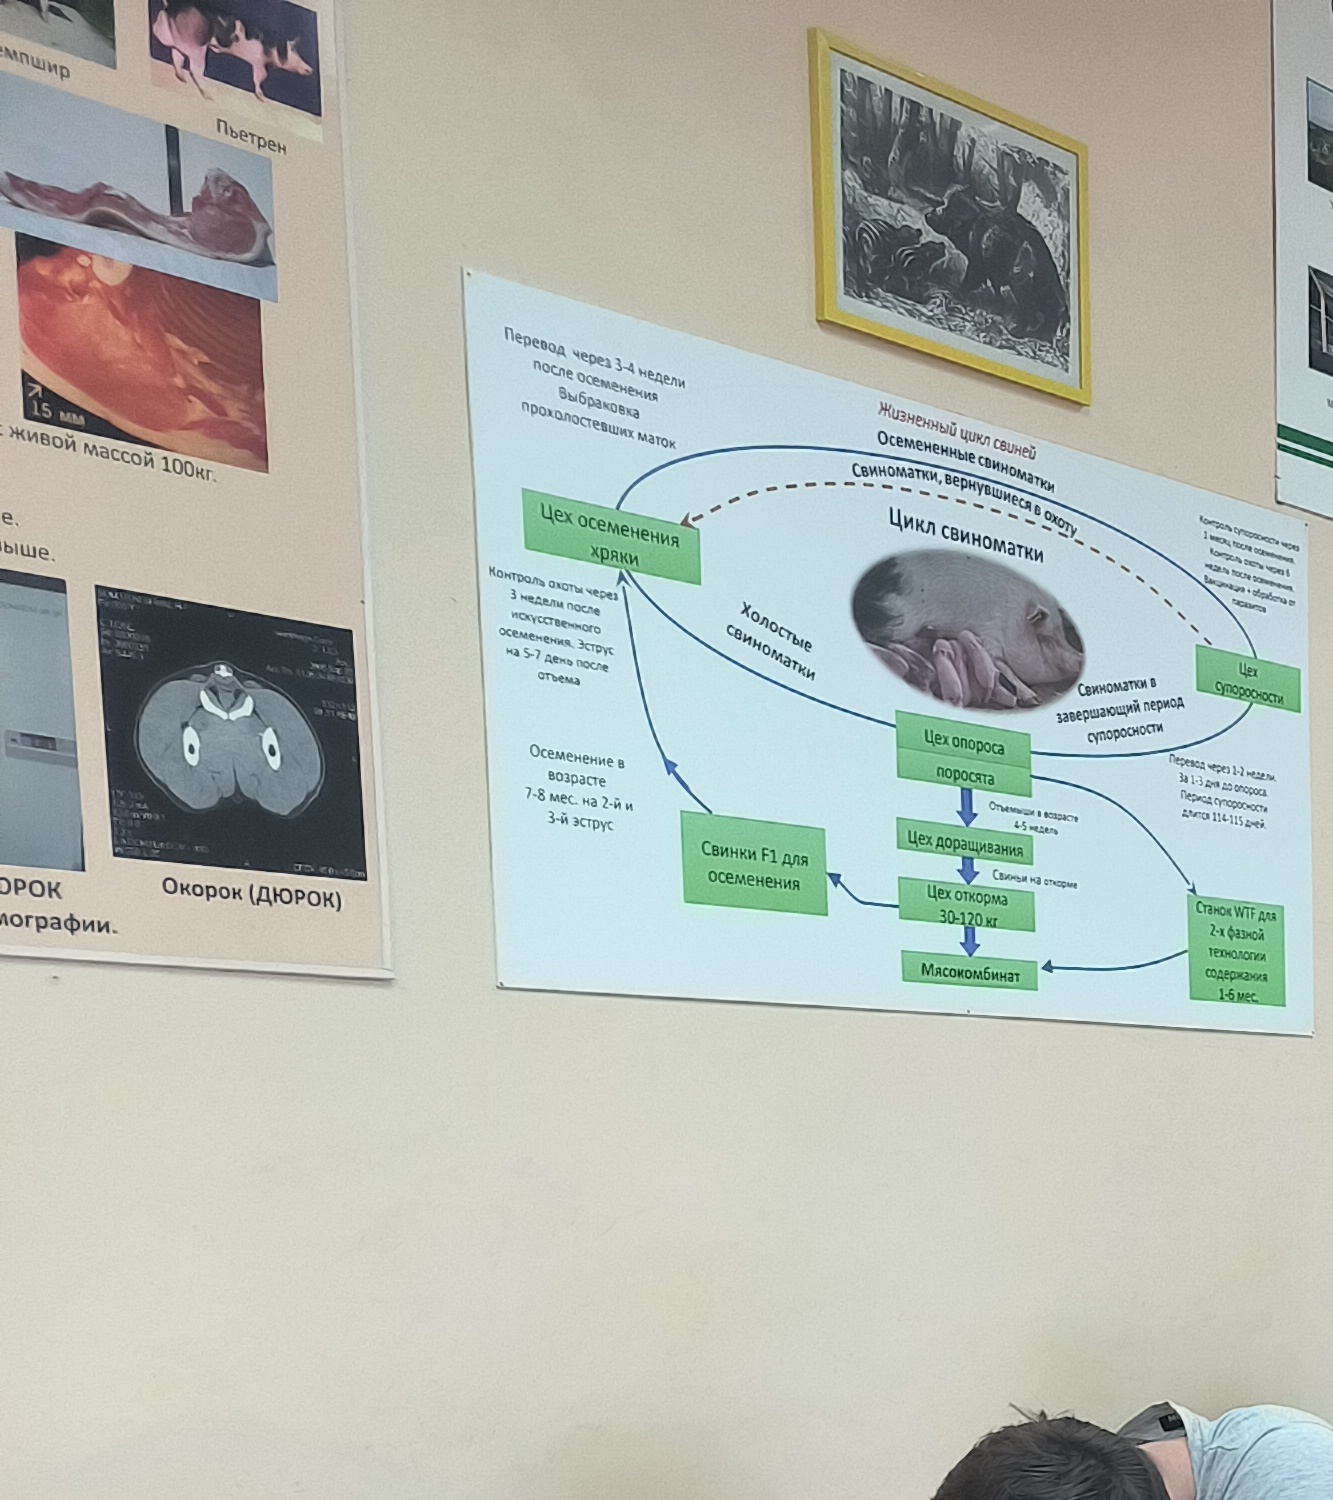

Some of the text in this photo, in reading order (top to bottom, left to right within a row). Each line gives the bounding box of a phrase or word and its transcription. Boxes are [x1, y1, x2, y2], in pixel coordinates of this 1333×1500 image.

[216, 118, 287, 156] Пьетрен
[505, 326, 686, 389] Перевод через 3-4 недели
[533, 360, 658, 402] после осеменения
[33, 400, 53, 418] 15
[558, 386, 640, 419] Выбраковка
[522, 401, 676, 449] прохолостевших маток
[878, 401, 1037, 461] Жизненный цикл свиней
[10, 425, 77, 453] живой
[84, 442, 155, 469] массой
[161, 456, 217, 483] 100кг.
[877, 430, 1055, 494] Осемененные свиноматки
[852, 462, 1078, 538] Свиноматки, вернувшиеся в охоту
[541, 502, 680, 548] Цех осеменения
[889, 506, 1044, 564] Цикл свиноматки
[0, 540, 55, 562] ыше.
[590, 545, 640, 567] хряки
[489, 566, 619, 601] Контроль охоты через
[510, 589, 600, 616] 3 недели после
[740, 601, 813, 653] Холостые
[506, 647, 609, 673] на 5-7 день после
[577, 639, 615, 656] Эструс
[726, 624, 816, 681] свиноматки
[1239, 662, 1259, 679] Цех
[1078, 677, 1157, 697] Свиноматки в
[1214, 680, 1284, 706] супоросности
[1056, 696, 1186, 724] завершающий период
[924, 728, 1005, 755] Цех опороса
[1087, 722, 1164, 745] супоросности
[530, 744, 625, 769] Осеменение в
[548, 771, 607, 788] возрасте
[936, 766, 995, 786] поросята
[525, 787, 546, 802] 7-8
[582, 797, 598, 808] на
[602, 796, 621, 811] 2-й
[626, 802, 634, 811] и
[548, 811, 614, 832] 3-й эструс
[701, 840, 809, 868] Свинки F1 для
[907, 829, 1024, 857] Цех доращивания
[708, 870, 800, 891] осеменения
[162, 877, 343, 912] Окорок (ДЮРОК)
[927, 884, 1008, 907] Цех откорма
[940, 909, 998, 927] 30-120 кг
[1196, 900, 1277, 923] Станок WTF для
[1209, 923, 1265, 941] 2-х фазной
[1209, 947, 1266, 962] технологии
[921, 962, 1021, 982] Мясокомбинат
[1205, 968, 1268, 982] содержания
[1219, 987, 1235, 1001] 1-6
